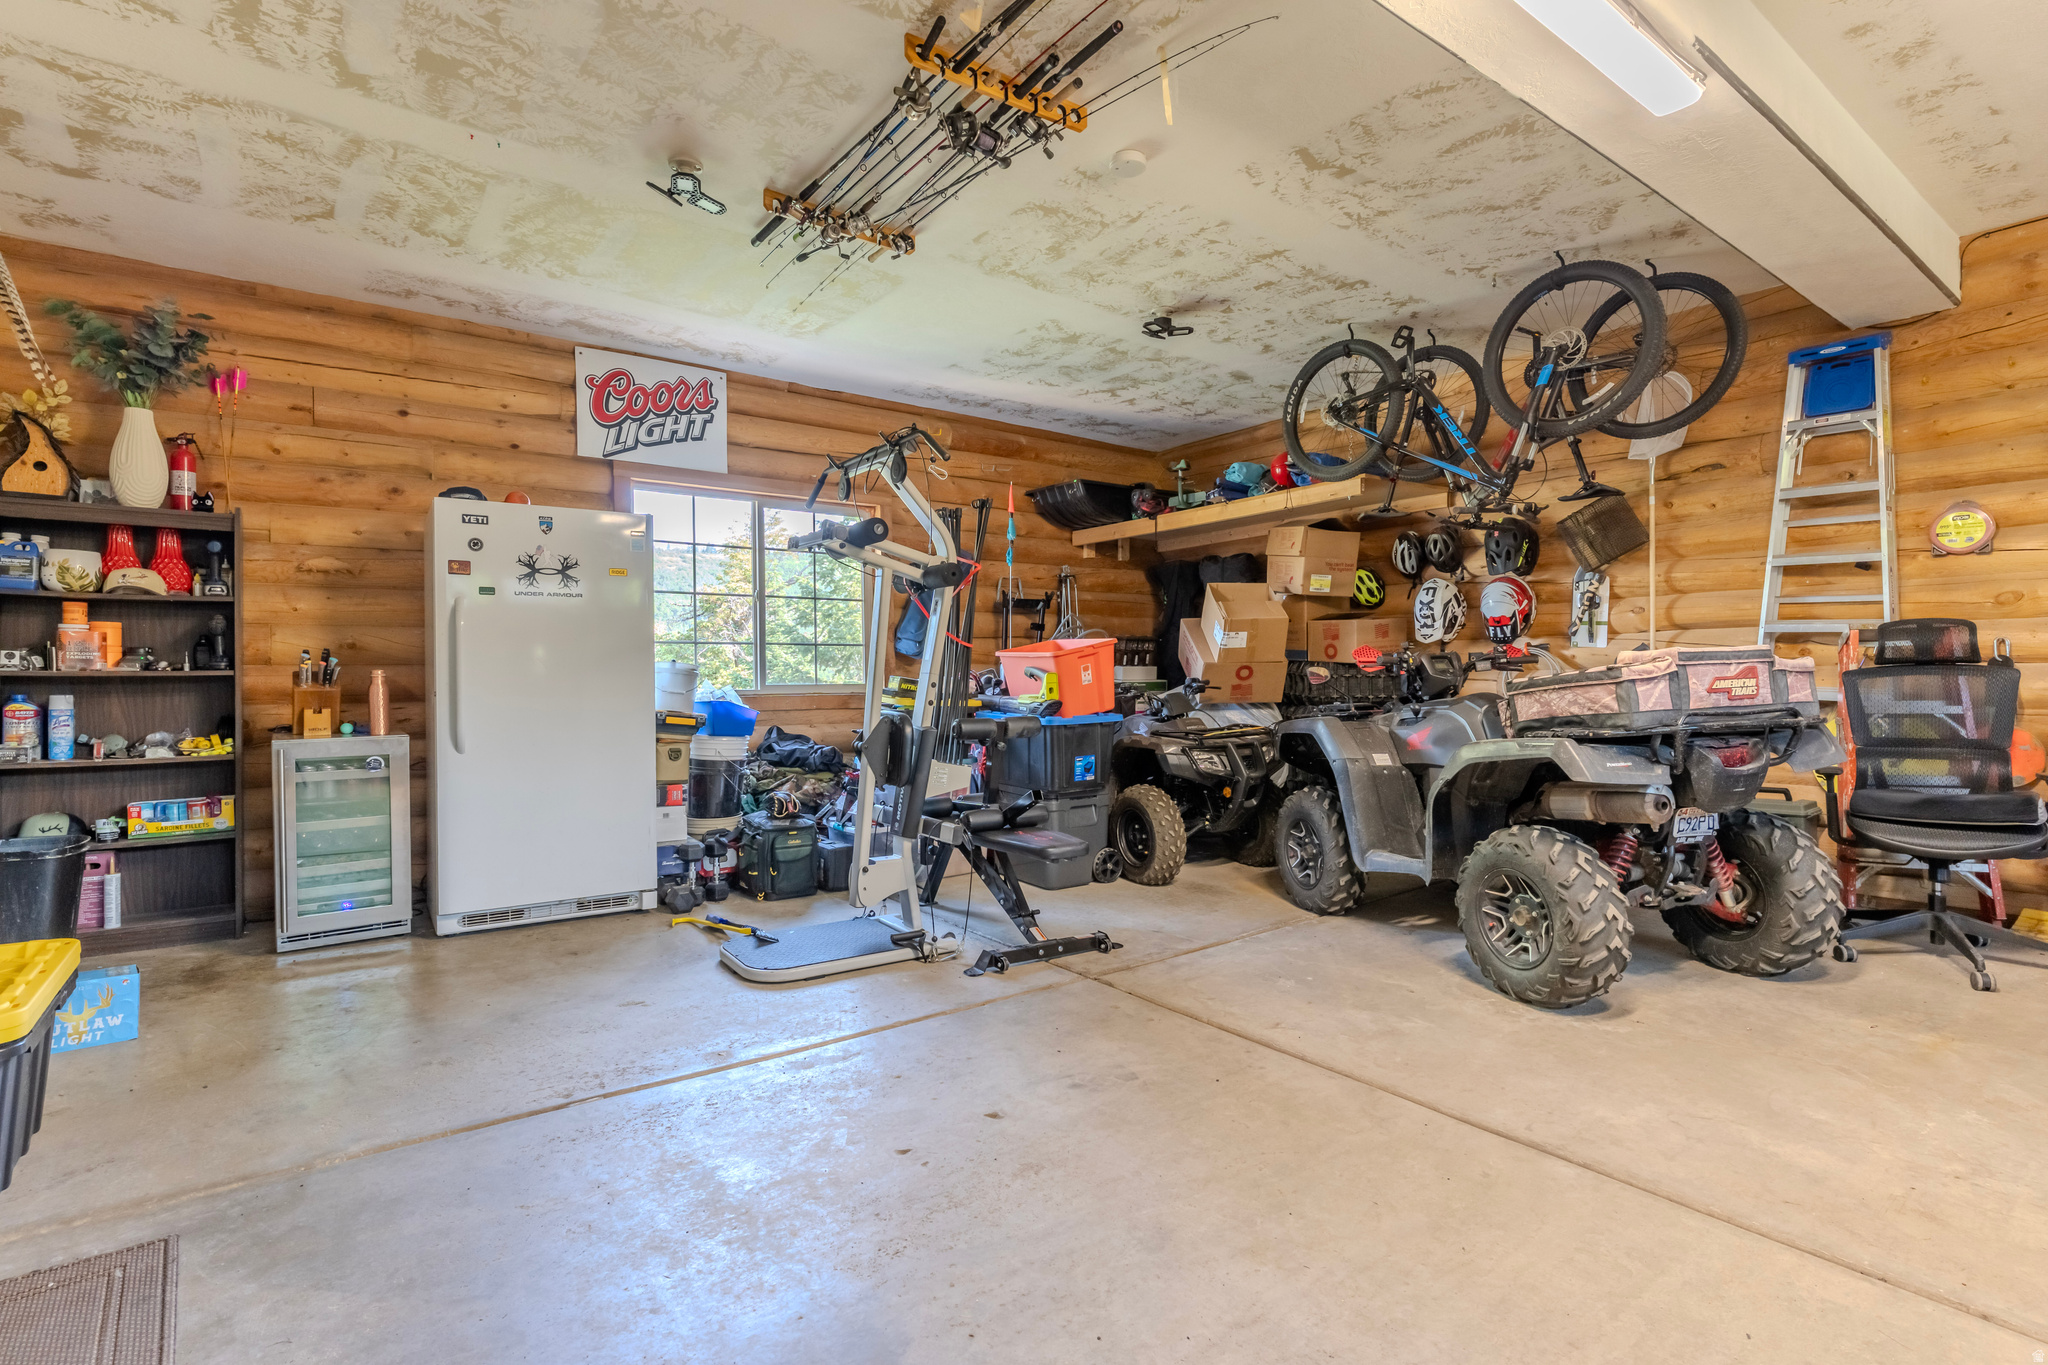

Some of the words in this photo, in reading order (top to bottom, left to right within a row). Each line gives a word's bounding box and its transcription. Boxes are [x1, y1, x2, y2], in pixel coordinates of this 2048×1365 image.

[585, 367, 719, 425] Coors
[1286, 379, 1303, 423] KENDA
[602, 411, 715, 459] LIGHT
[1432, 403, 1476, 455] TREK
[462, 515, 488, 524] YETI
[1488, 626, 1512, 638] FLY
[1711, 678, 1757, 689] AMERICAN
[1731, 686, 1758, 696] TRAILS
[184, 822, 210, 830] FILLETS
[1676, 815, 1715, 835] C92PD
[52, 1013, 124, 1037] UTLAW
[51, 1030, 105, 1049] LIGHT
